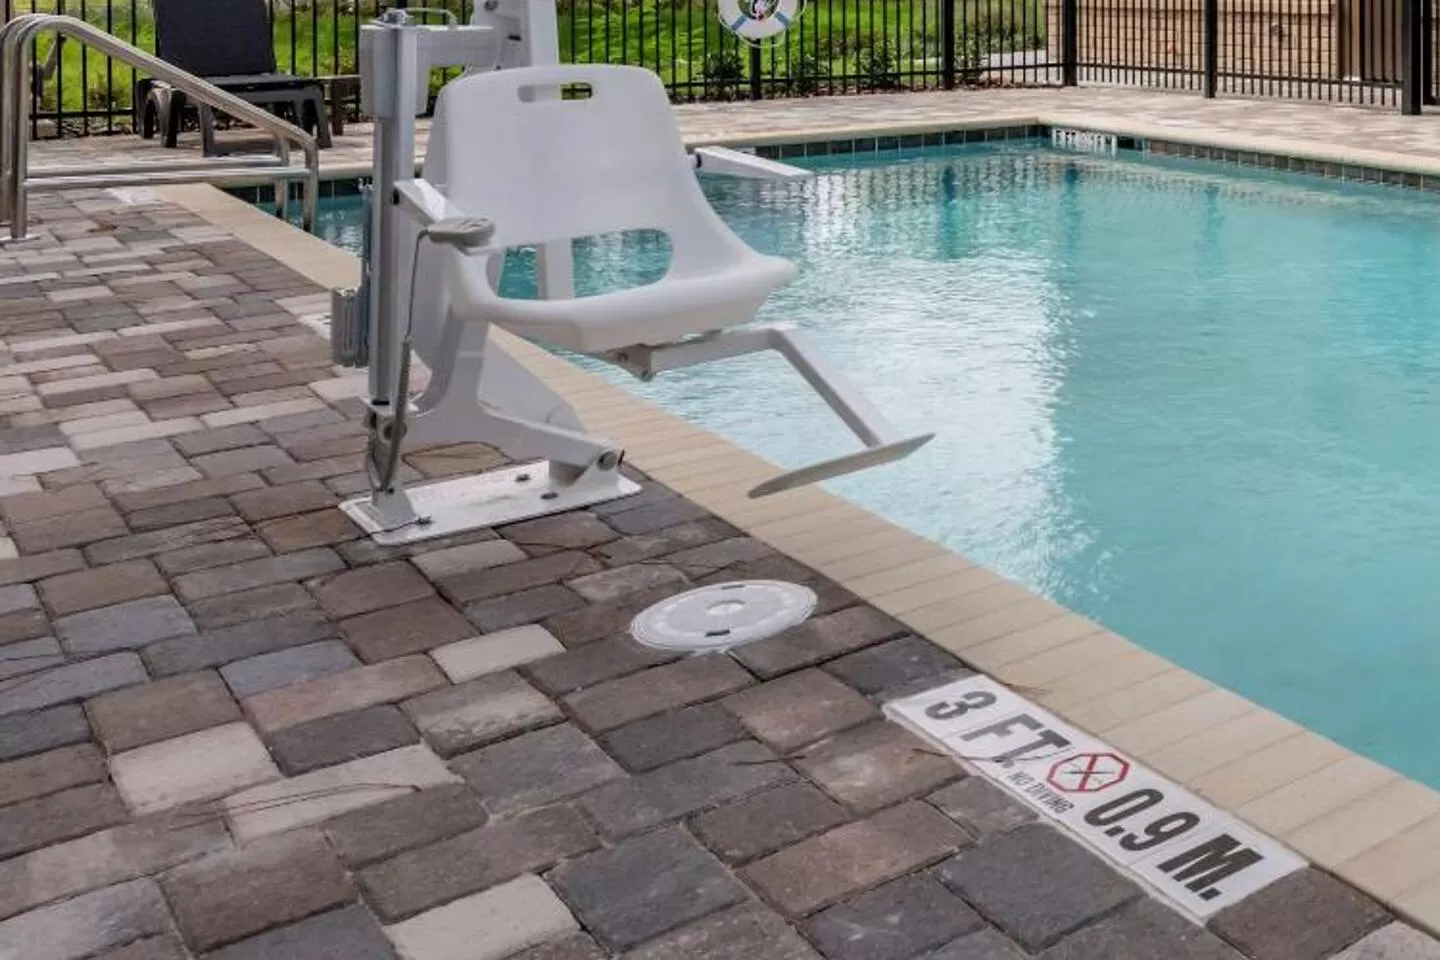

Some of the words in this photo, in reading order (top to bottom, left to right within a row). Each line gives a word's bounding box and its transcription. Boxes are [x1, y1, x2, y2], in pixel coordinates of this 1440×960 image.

[924, 691, 997, 721] 3
[1083, 788, 1201, 852] 0.9
[1155, 833, 1265, 901] M.
[1008, 771, 1036, 787] NO
[1025, 781, 1075, 814] DIVING
